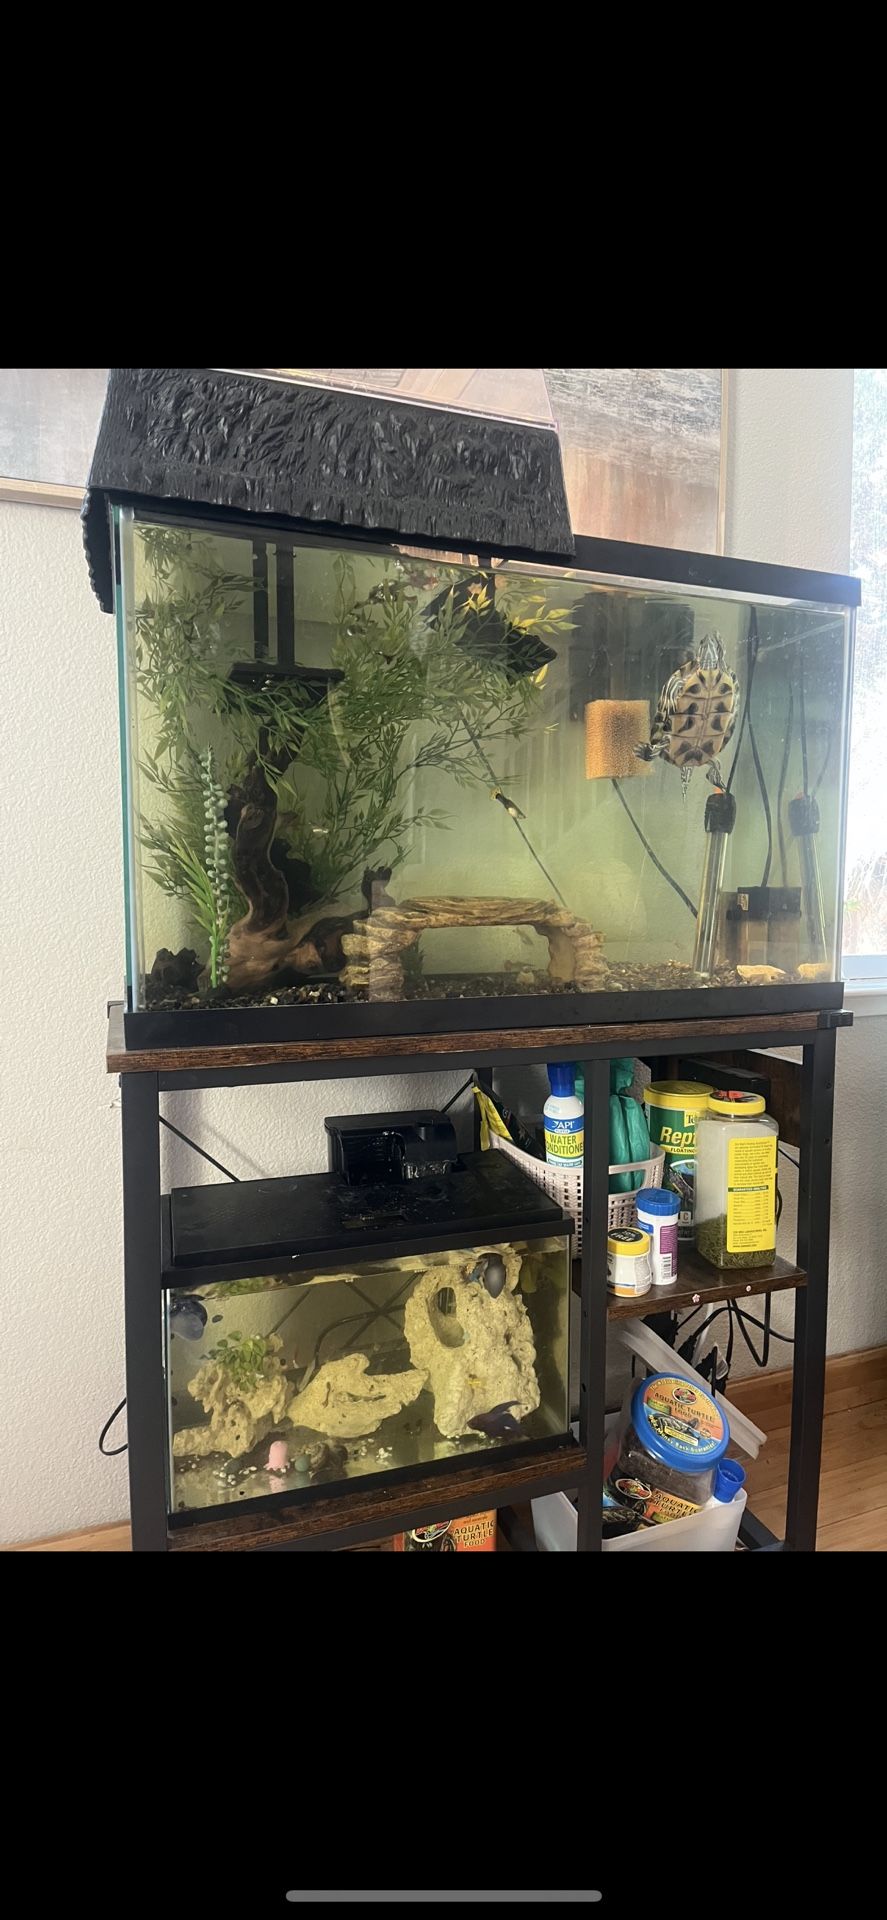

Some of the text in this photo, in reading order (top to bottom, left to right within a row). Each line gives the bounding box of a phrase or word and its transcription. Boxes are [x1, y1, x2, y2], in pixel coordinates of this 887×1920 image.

[557, 1121, 573, 1129] API
[550, 1134, 577, 1145] WATER
[547, 1141, 583, 1155] ONDITIONE
[655, 1392, 684, 1410] AQUATIC
[687, 1407, 713, 1421] TURTLE
[454, 1519, 494, 1535] AQUATIC
[456, 1528, 493, 1542] TURTLE
[464, 1538, 485, 1548] FOOD
